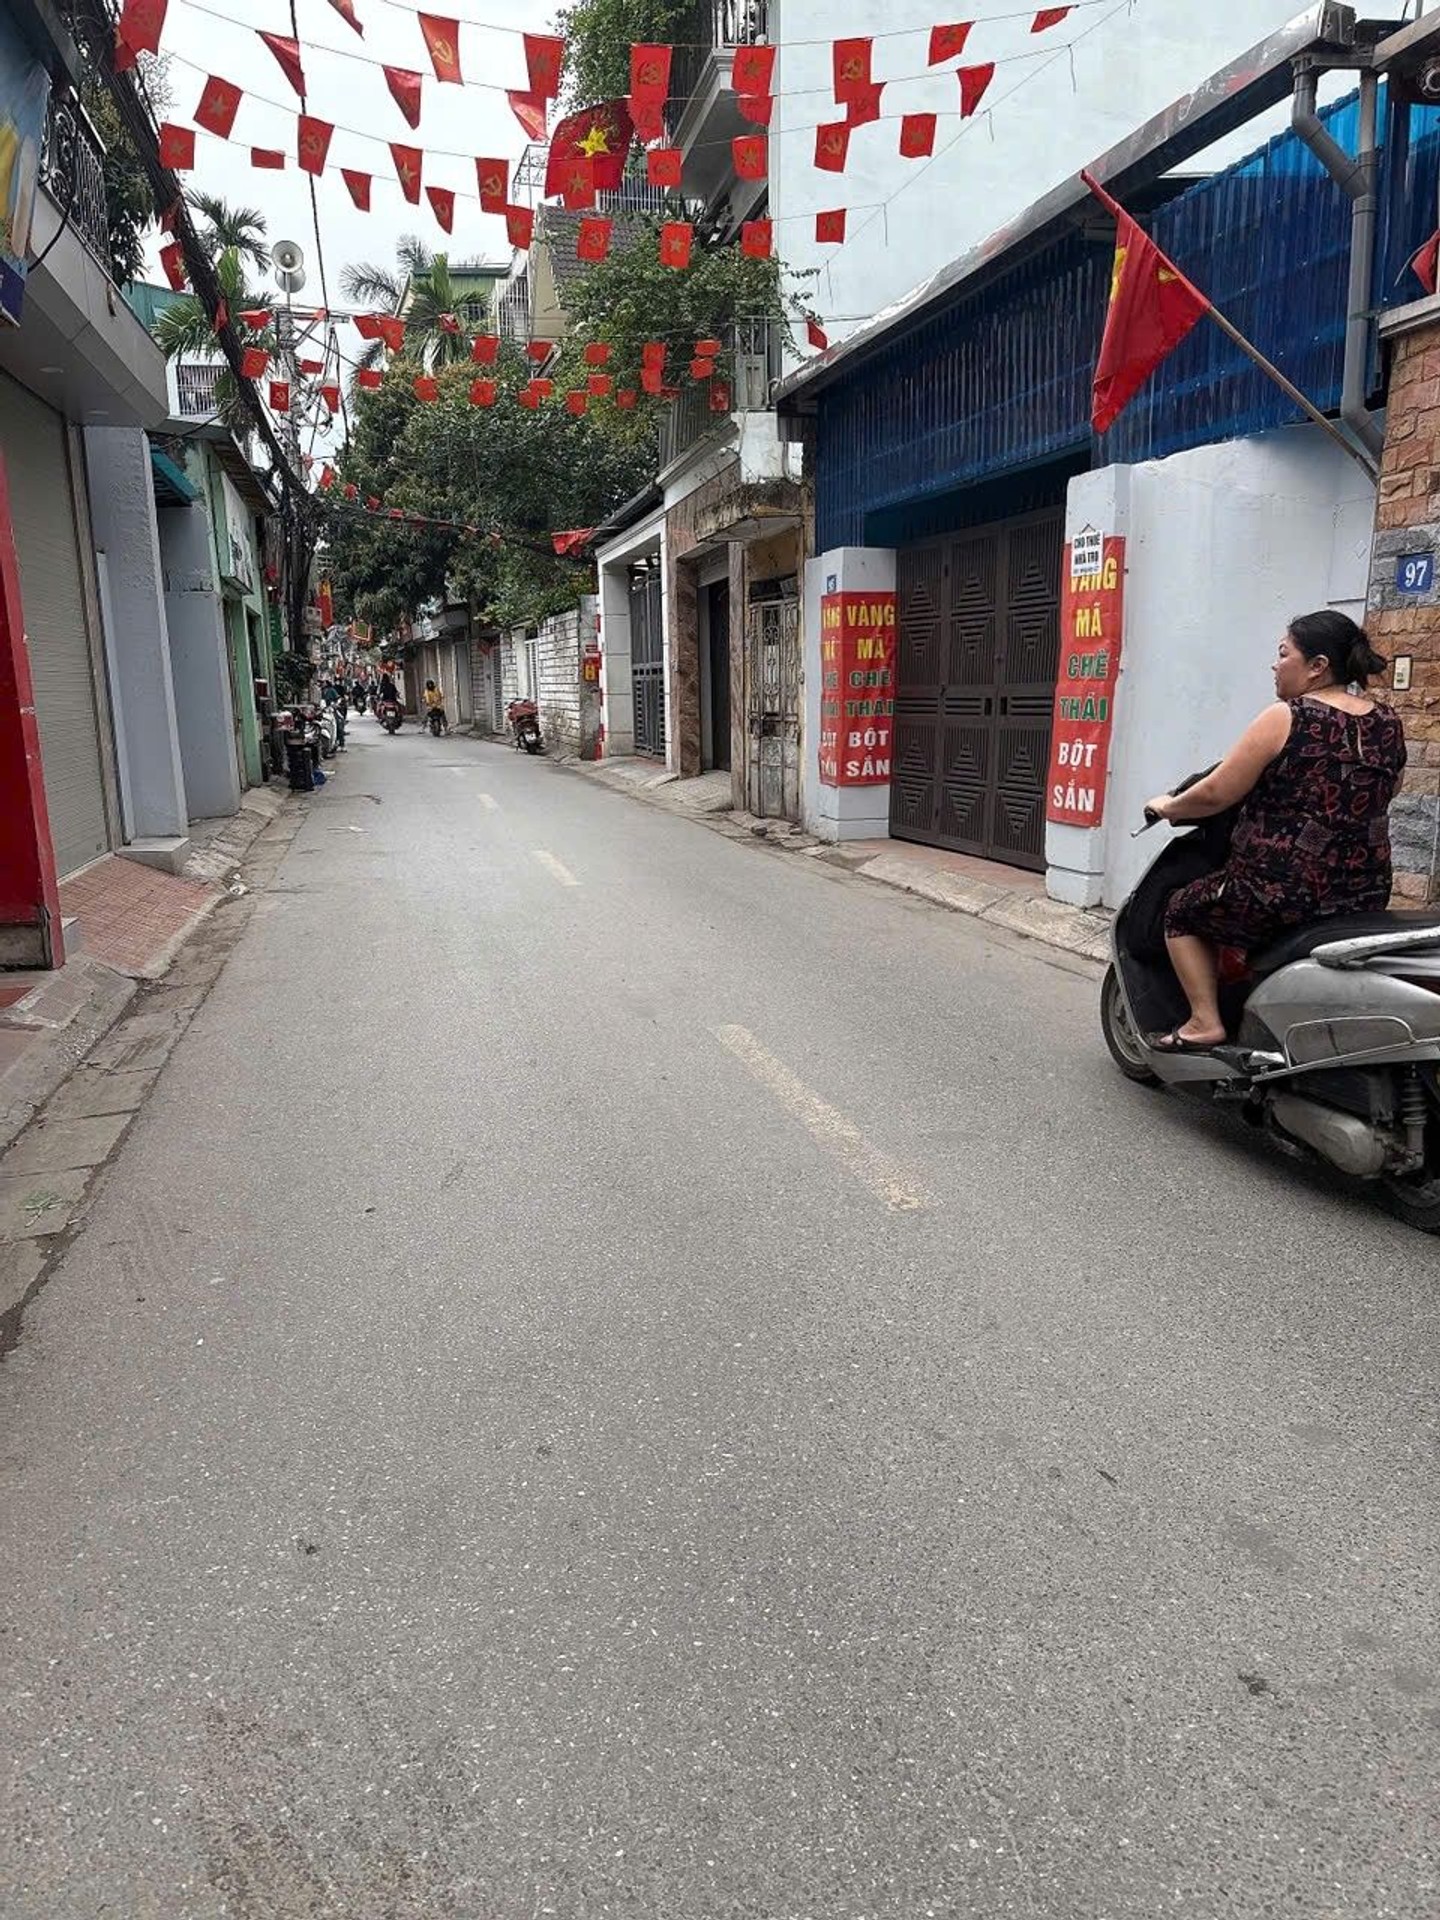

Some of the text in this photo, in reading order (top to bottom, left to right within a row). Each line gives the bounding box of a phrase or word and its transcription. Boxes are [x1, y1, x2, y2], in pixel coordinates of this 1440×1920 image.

[1404, 560, 1428, 588] 97
[846, 600, 895, 627] VÀNG
[1076, 601, 1102, 637] MÃ
[857, 634, 885, 659] MÃ
[849, 727, 889, 750] BỘT
[846, 755, 890, 777] SẮN
[1058, 738, 1098, 771] BỘT
[1053, 779, 1095, 812] SẮN
